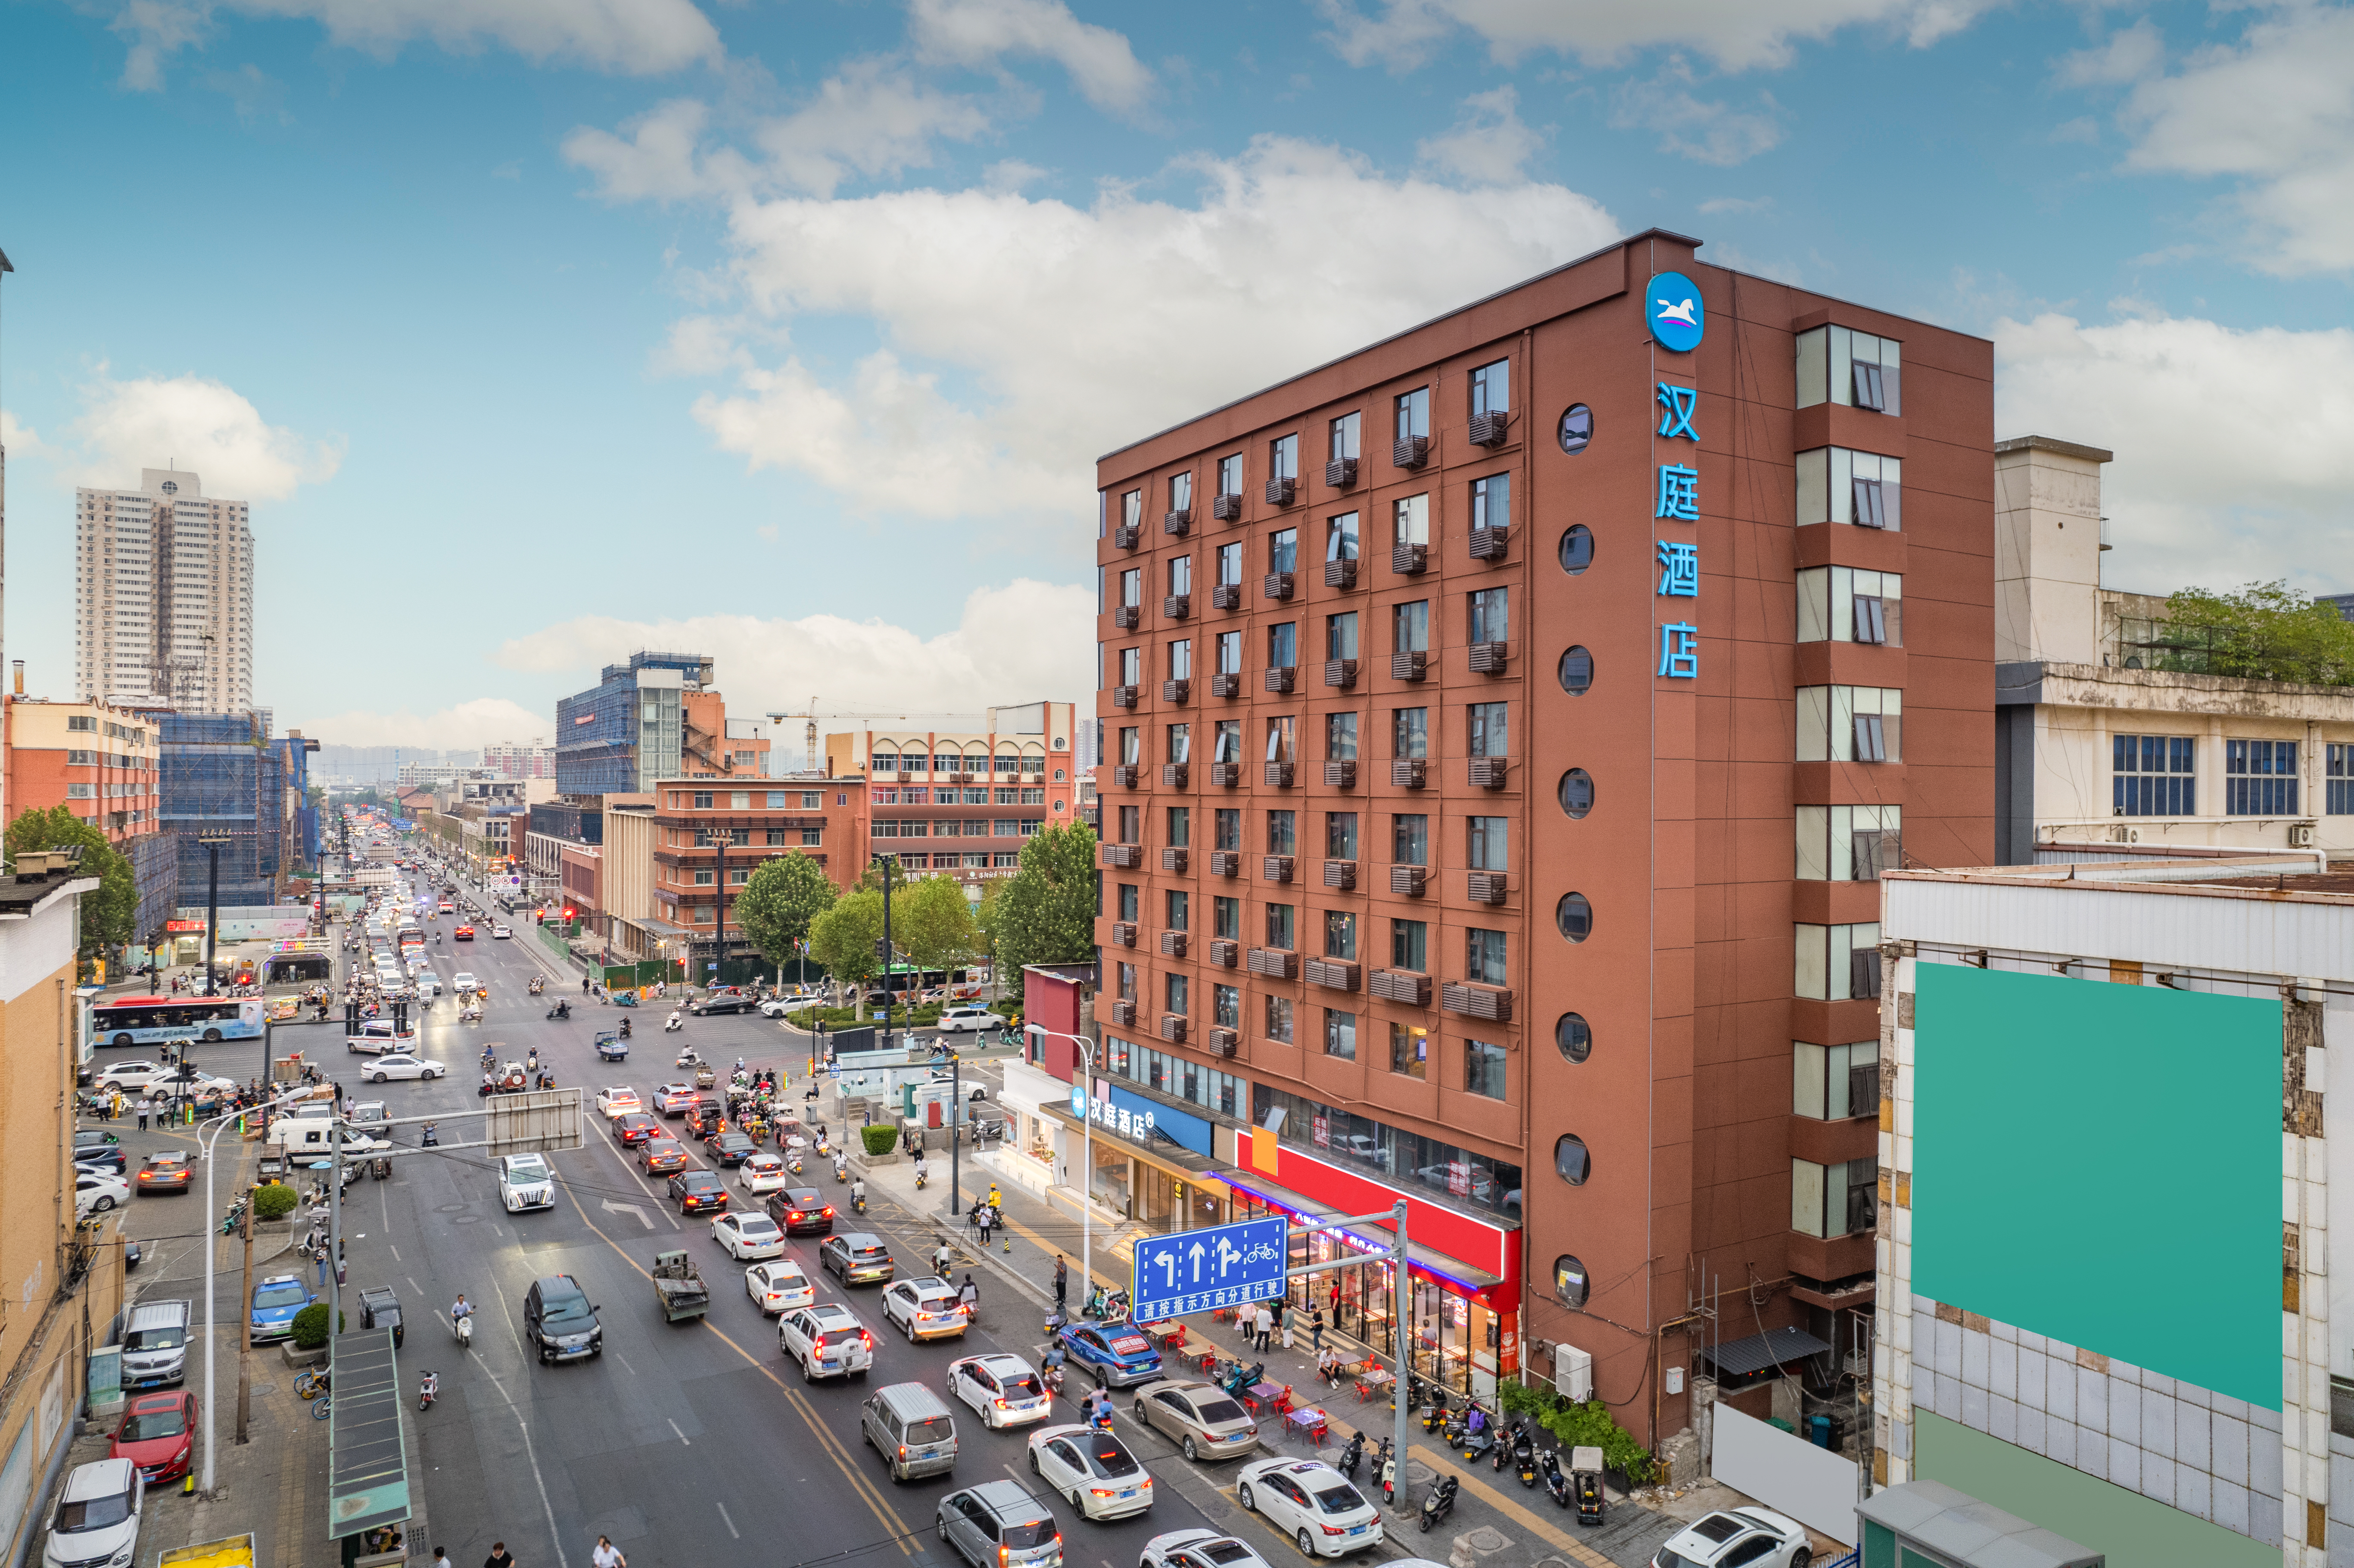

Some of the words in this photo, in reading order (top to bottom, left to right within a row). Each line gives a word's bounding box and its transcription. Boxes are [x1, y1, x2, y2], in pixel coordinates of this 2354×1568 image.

[1656, 381, 1700, 679] 汉庭酒店
[1090, 1096, 1145, 1141] 汉庭酒店
[1315, 1117, 1327, 1129] 旺铺
[1314, 1126, 1326, 1138] 招租
[1451, 1163, 1466, 1177] 旺铺
[1450, 1173, 1466, 1187] 招租
[1144, 1281, 1278, 1319] 请按指示方向分道行驶
